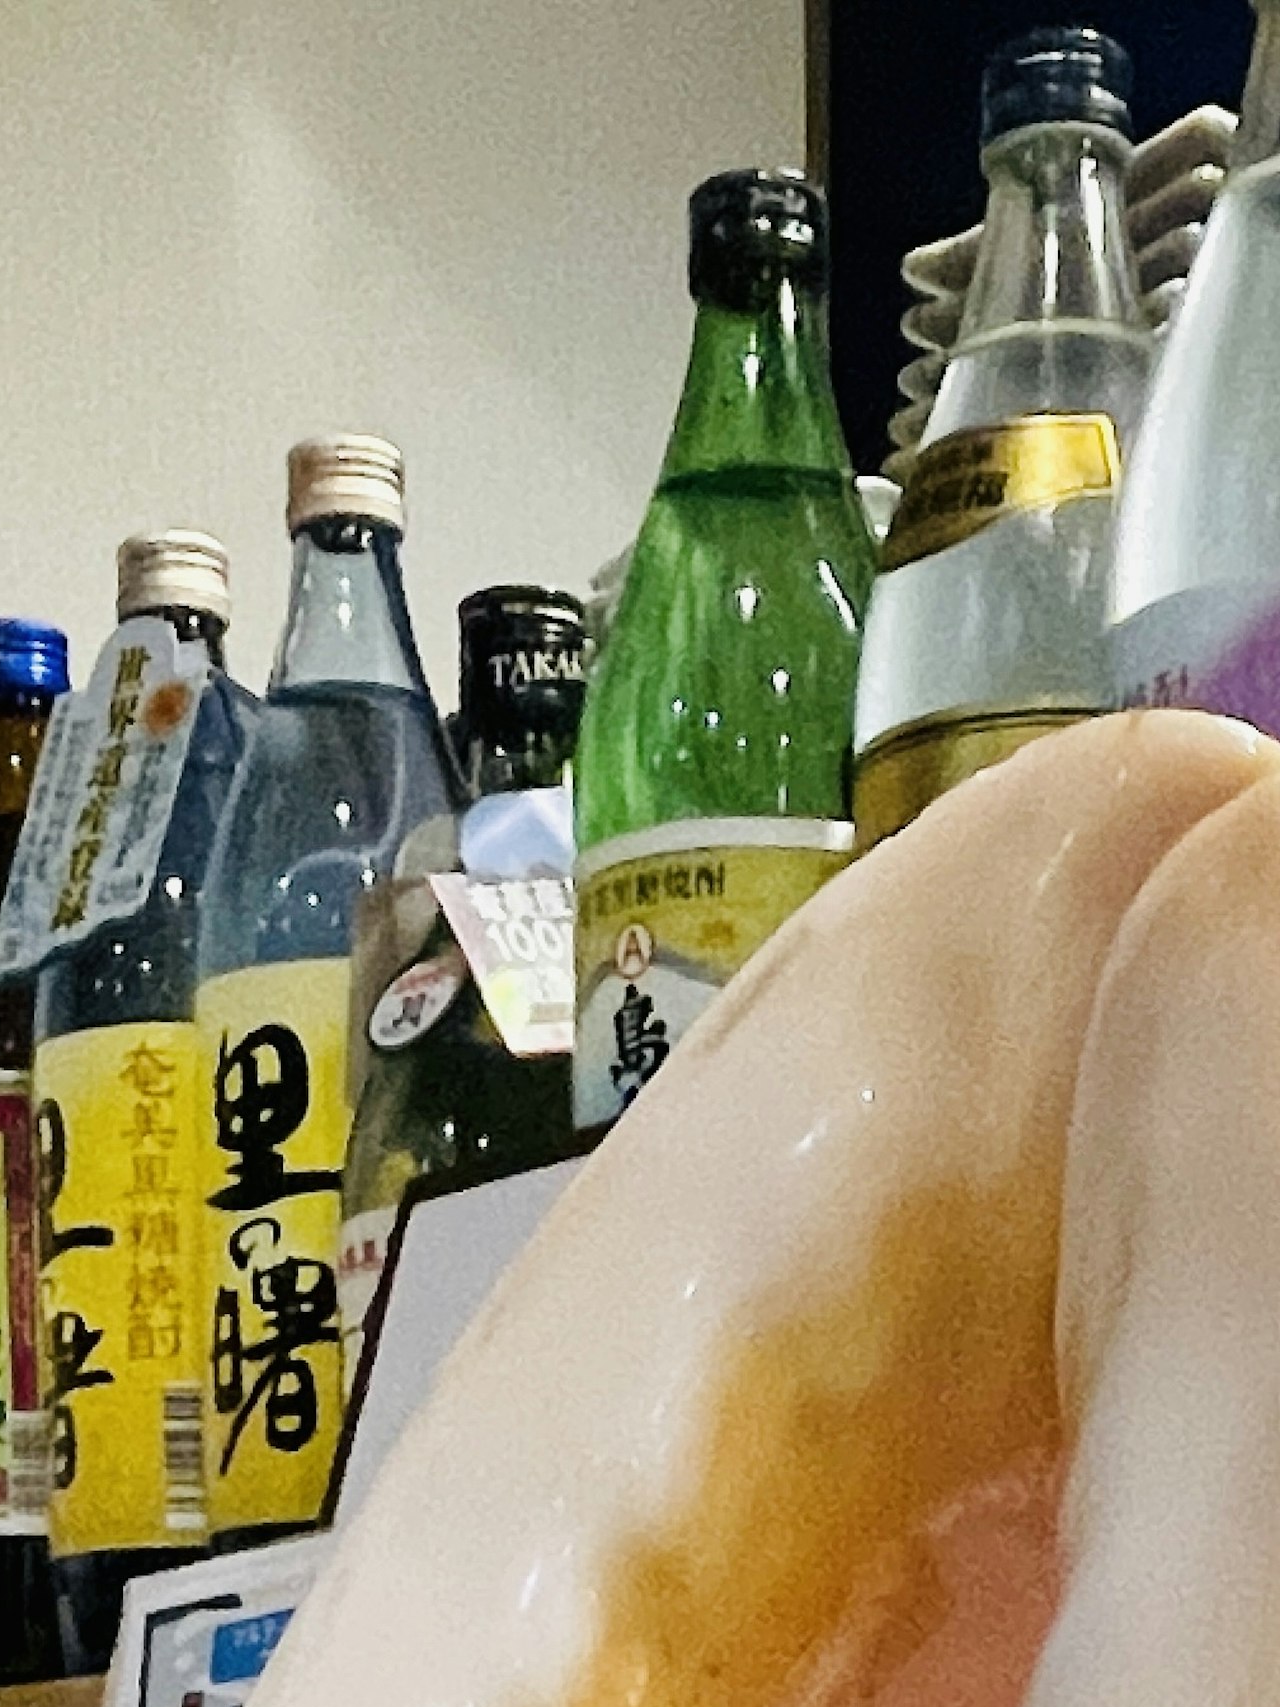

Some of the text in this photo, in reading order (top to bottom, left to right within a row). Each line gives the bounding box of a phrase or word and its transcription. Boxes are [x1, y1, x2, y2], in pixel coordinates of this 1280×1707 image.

[119, 1040, 178, 1361] 奄美黒糖焼酎
[208, 1023, 342, 1475] 里の曙
